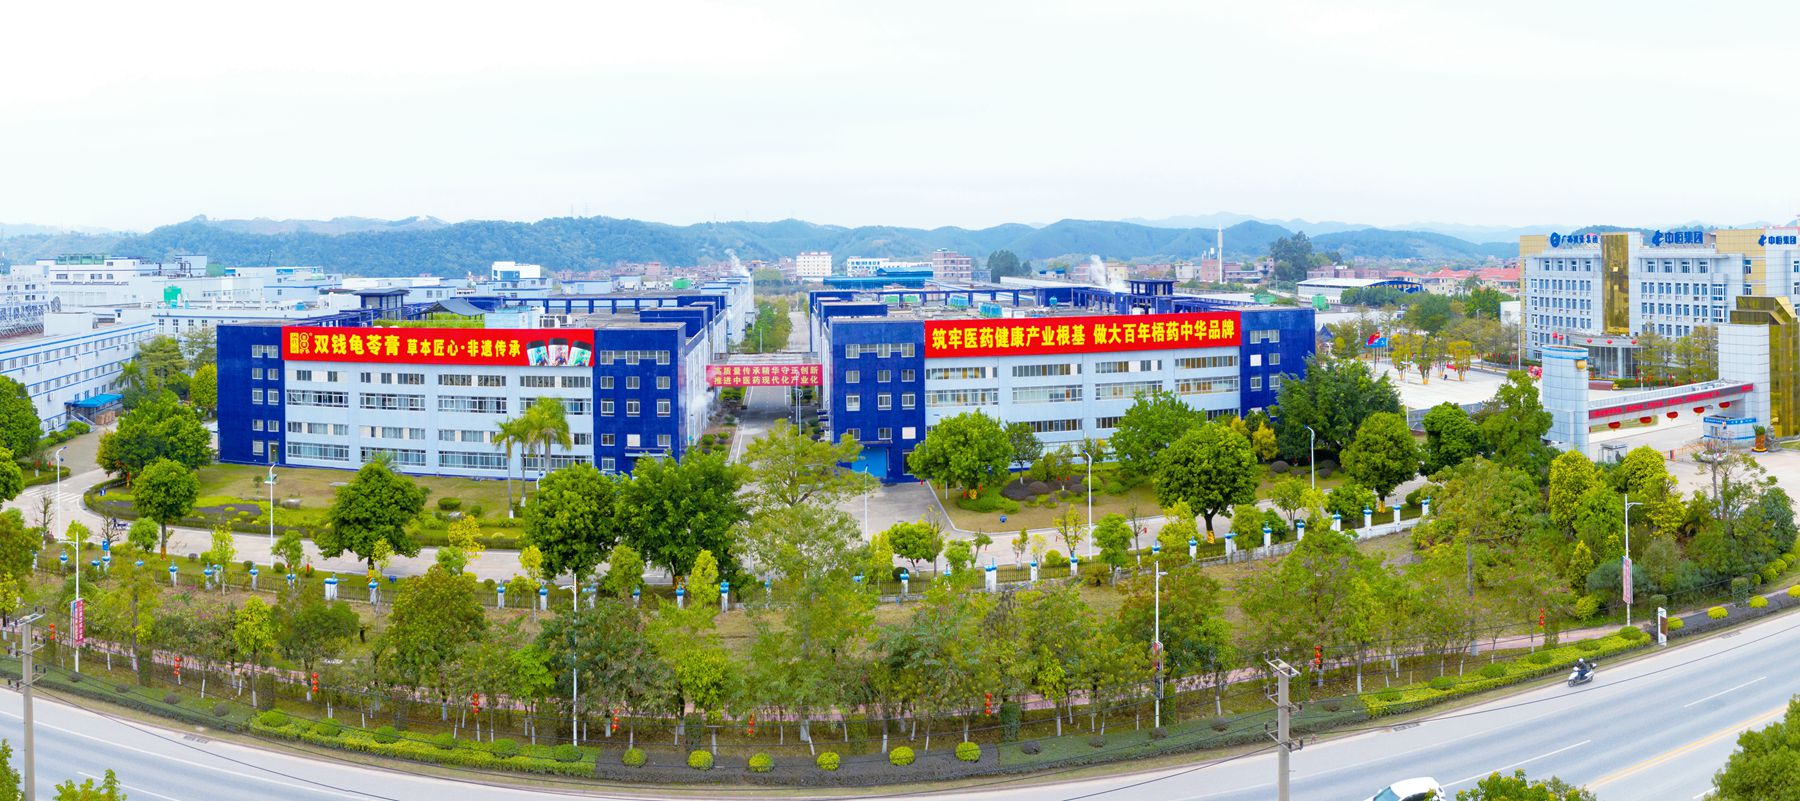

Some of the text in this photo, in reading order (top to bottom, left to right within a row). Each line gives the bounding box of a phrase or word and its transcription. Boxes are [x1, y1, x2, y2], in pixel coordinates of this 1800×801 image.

[1665, 231, 1703, 244] 中恒集团
[1768, 235, 1797, 245] 中恒集团
[931, 319, 1236, 350] 筑牢医药健康产业根基 做大百年梧药中华品牌
[314, 334, 400, 356] 双钱龟苓膏
[407, 339, 521, 357] 草本匠心·非遗传承
[714, 366, 819, 375] 高质量传承精华守正创新
[713, 375, 819, 385] 推进中医药现代化产业化
